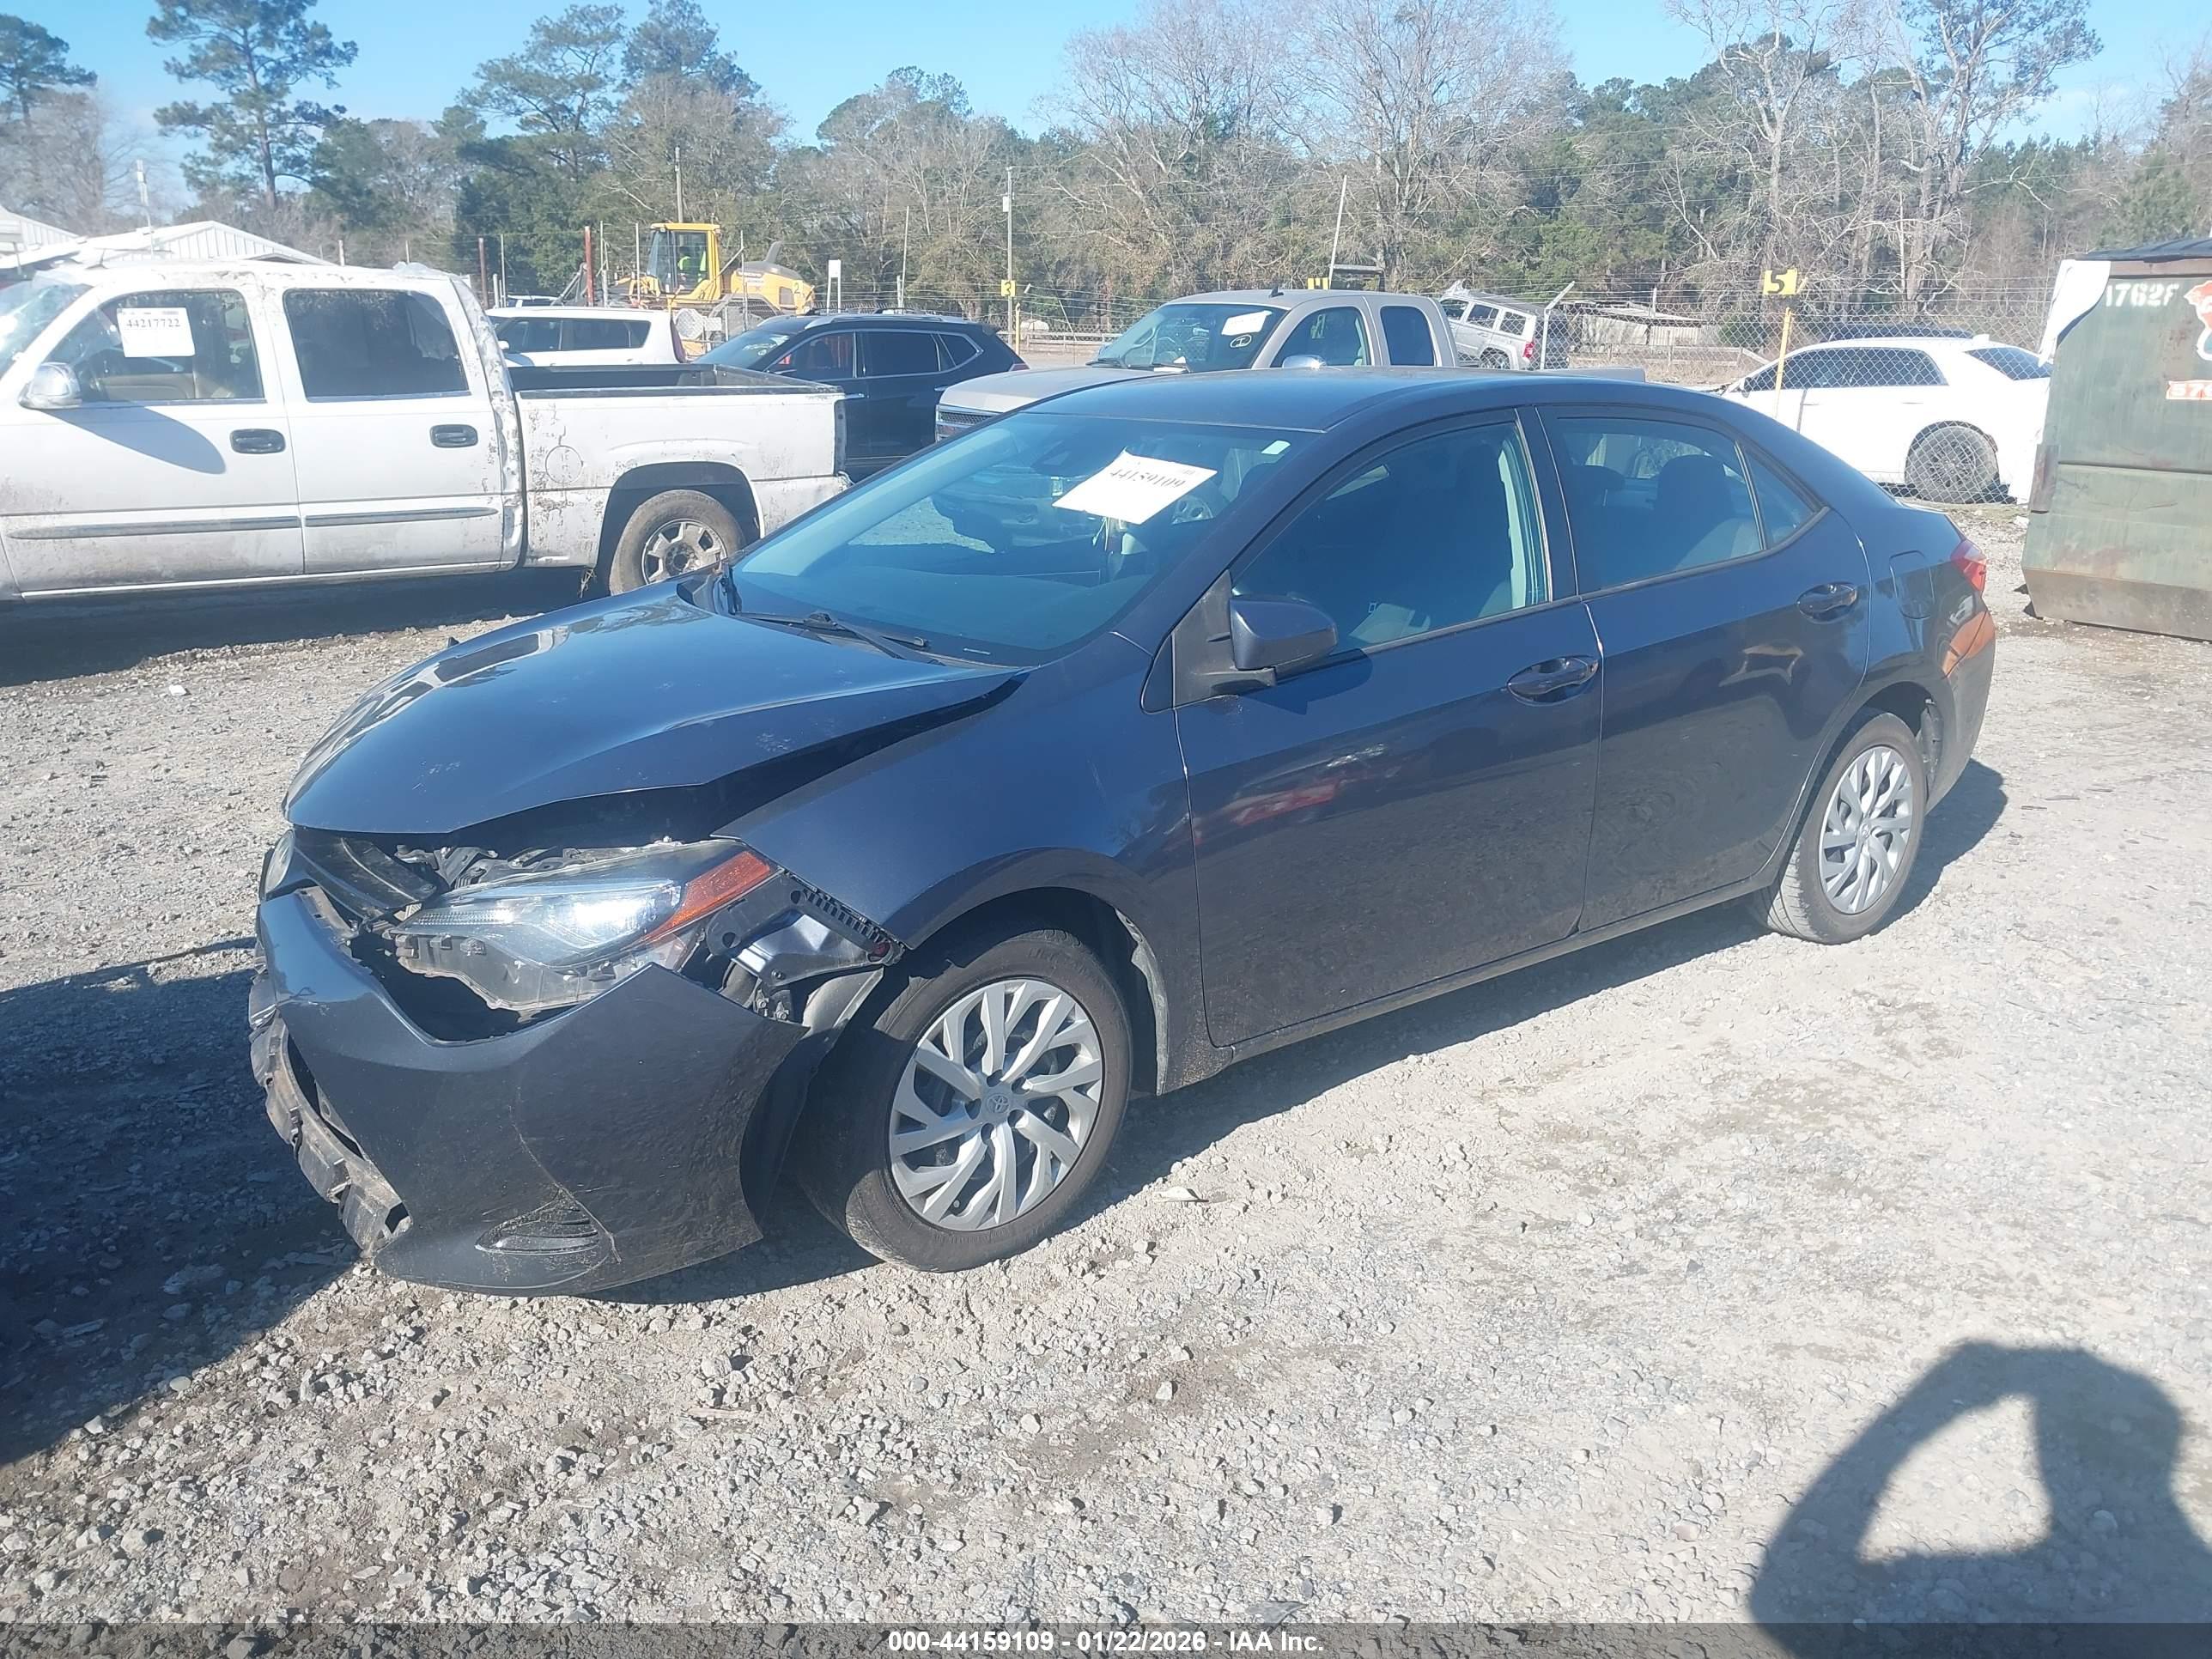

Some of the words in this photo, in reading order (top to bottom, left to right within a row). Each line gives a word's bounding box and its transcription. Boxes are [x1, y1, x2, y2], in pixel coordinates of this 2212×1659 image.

[793, 282, 800, 294] 2
[1004, 281, 1012, 296] 3
[1767, 268, 1788, 294] 5
[126, 318, 181, 328] 44217722
[1109, 468, 1187, 489] 44159109
